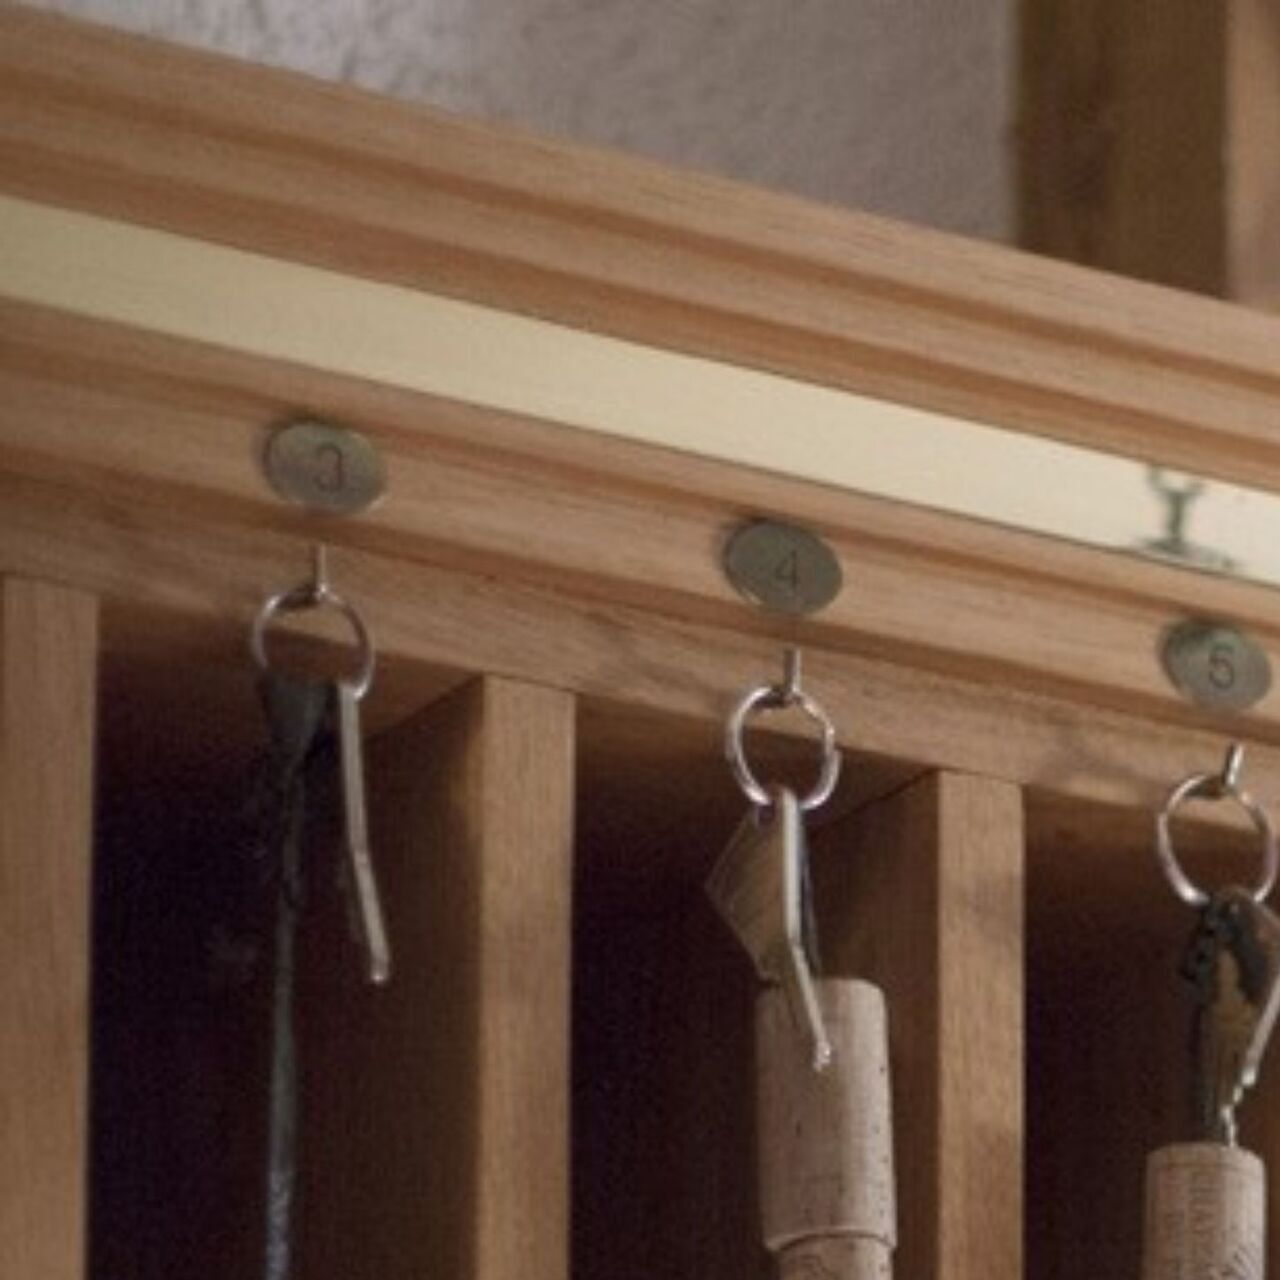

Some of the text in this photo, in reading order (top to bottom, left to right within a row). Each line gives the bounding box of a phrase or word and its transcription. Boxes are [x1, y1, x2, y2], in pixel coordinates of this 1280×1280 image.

[313, 441, 343, 493] 3
[774, 547, 799, 591] 4
[1208, 641, 1235, 690] 5
